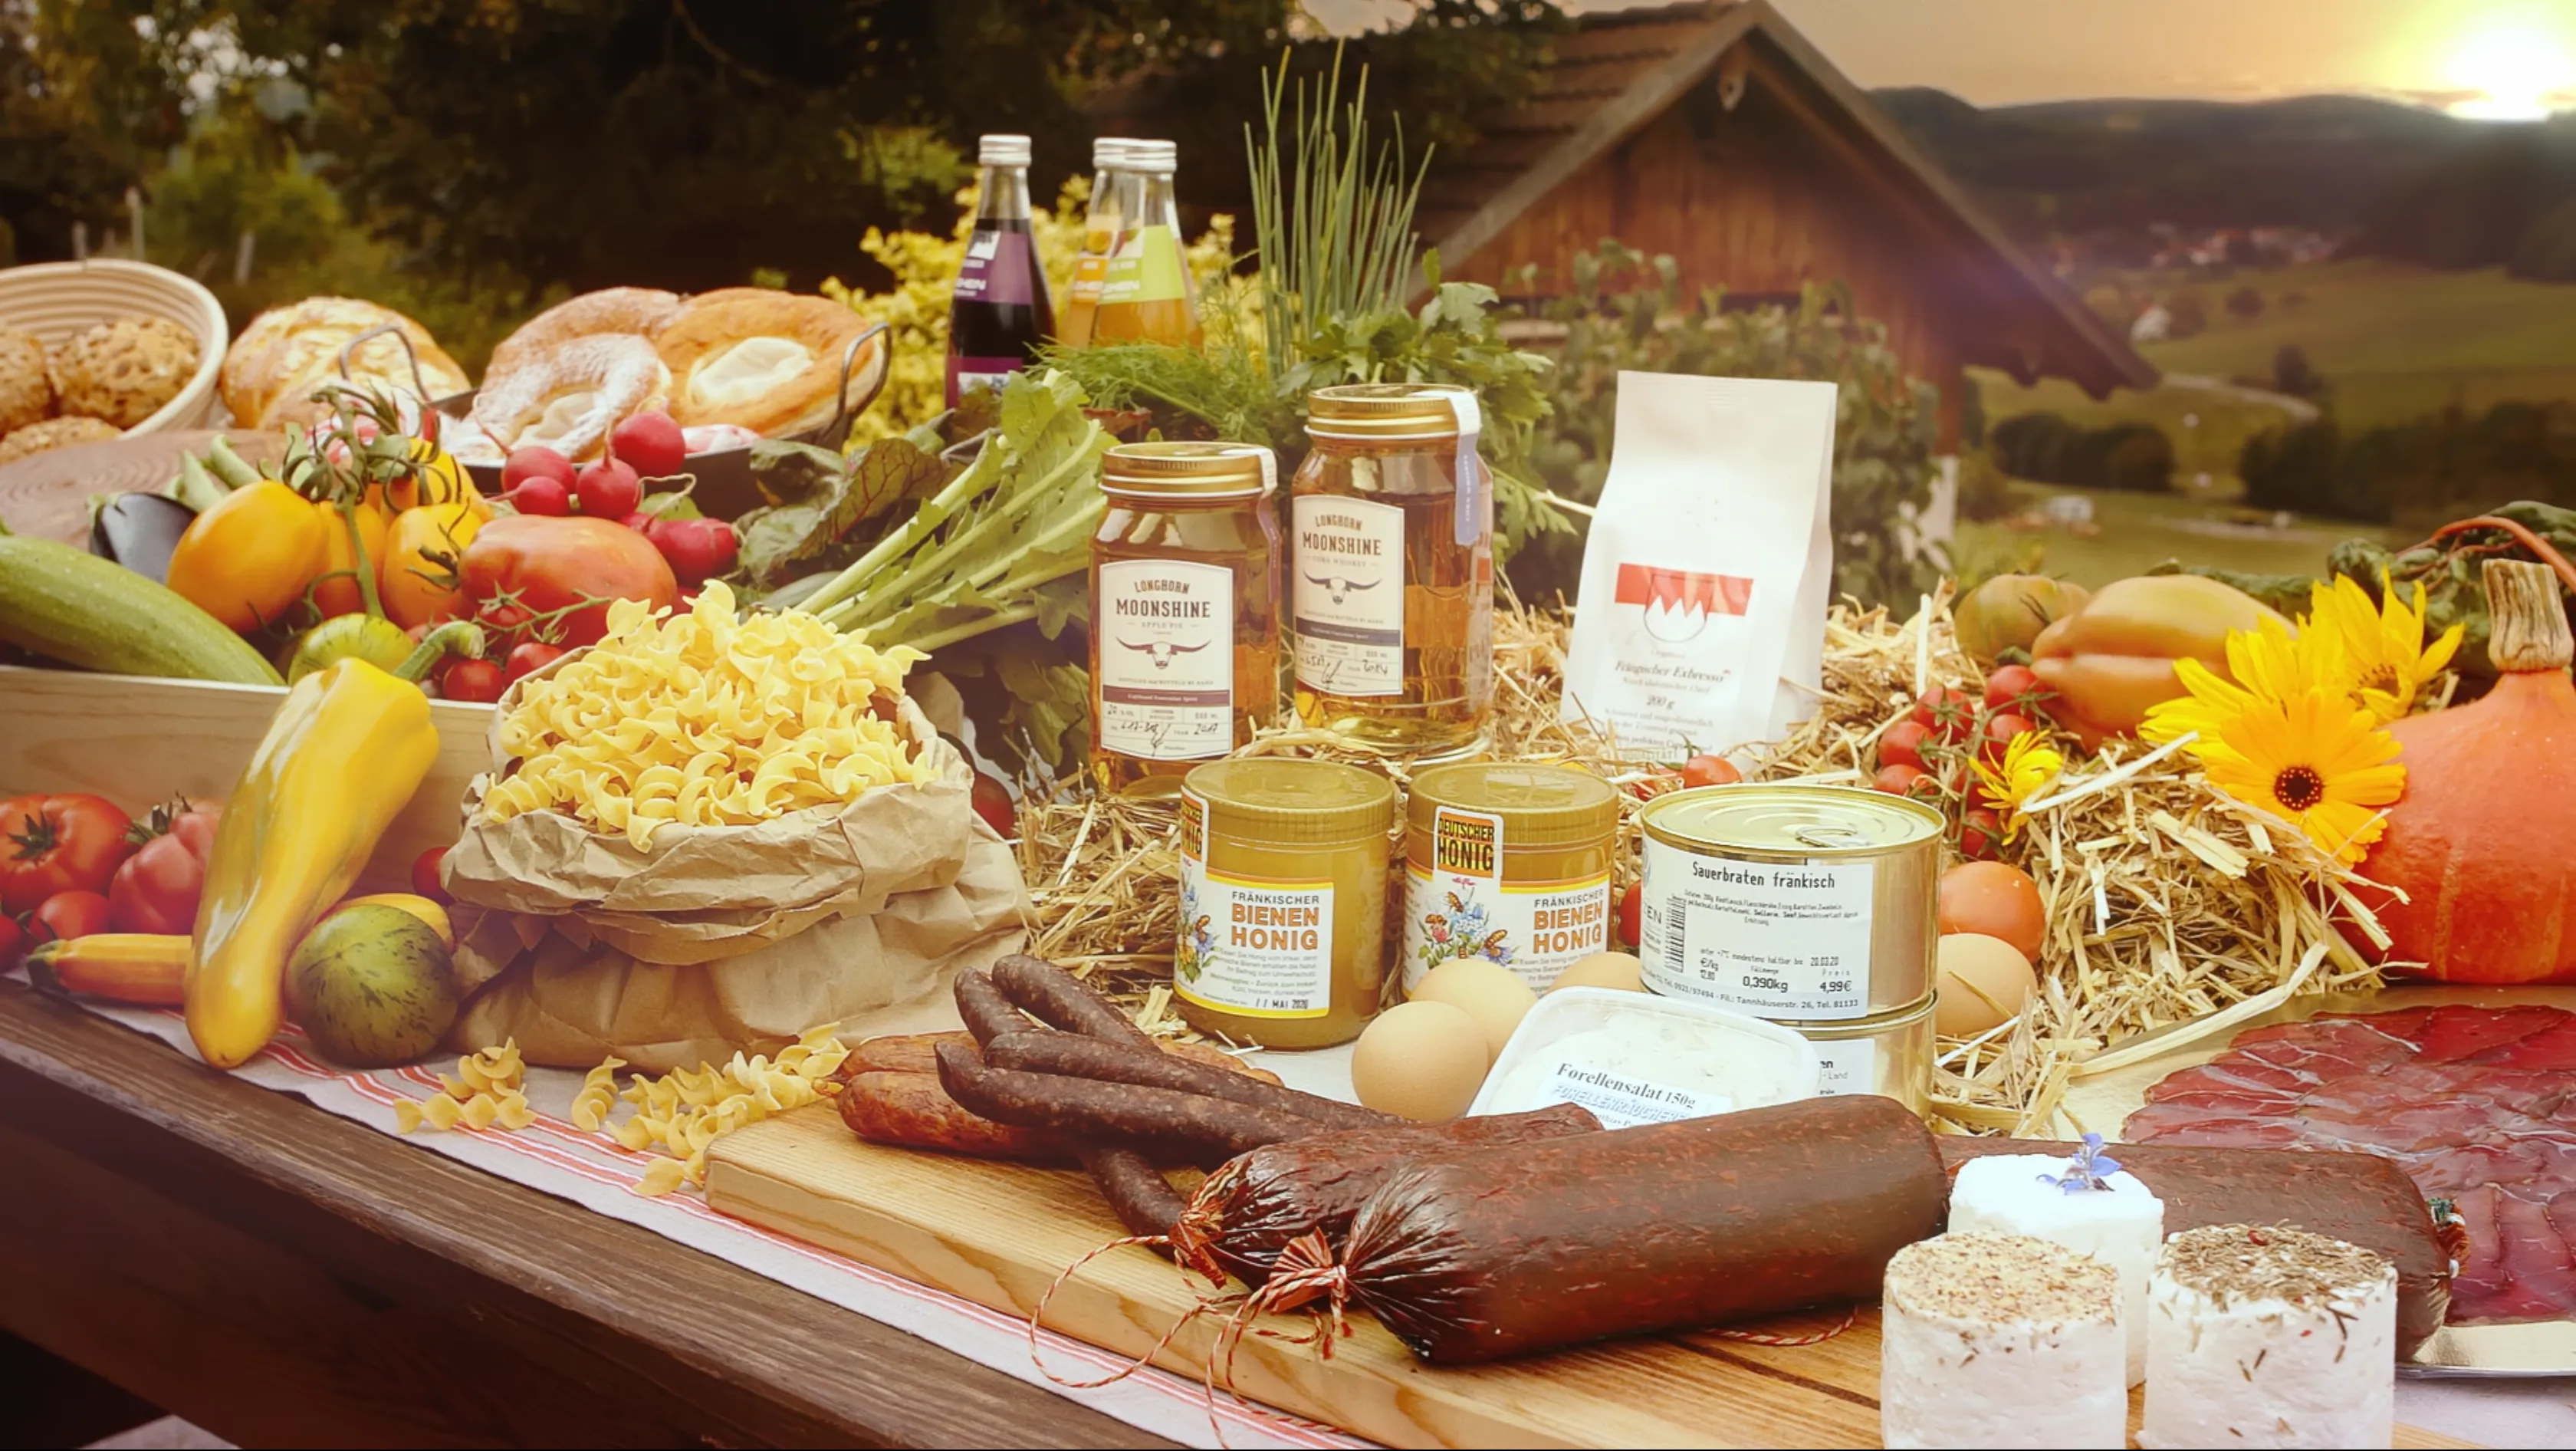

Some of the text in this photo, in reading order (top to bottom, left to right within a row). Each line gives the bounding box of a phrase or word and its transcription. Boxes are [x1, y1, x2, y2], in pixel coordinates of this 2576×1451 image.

[1303, 531, 1382, 556] MOONSHINE
[1116, 598, 1211, 618] MOONSHINE
[1438, 817, 1495, 844] DEUTSCHER
[1438, 837, 1494, 871] HONIG
[1692, 860, 1835, 889] Sauerbraten fränkisch
[1232, 890, 1319, 905] FRÄNKISCHER
[1534, 888, 1604, 909] FRÄNKISCHER
[1231, 903, 1319, 927] BIENEN
[1534, 900, 1603, 930] BIENEN
[1230, 925, 1319, 951] HONIG
[1533, 923, 1602, 955] HONIG
[1742, 976, 1789, 994] 0,390kg
[1819, 979, 1852, 995] 4,99€
[1272, 999, 1289, 1009] MAI
[1737, 995, 1799, 1008] Tannhäuserstr.
[1833, 999, 1858, 1008] 81133
[1556, 1062, 1696, 1110] Forellensalat 150g
